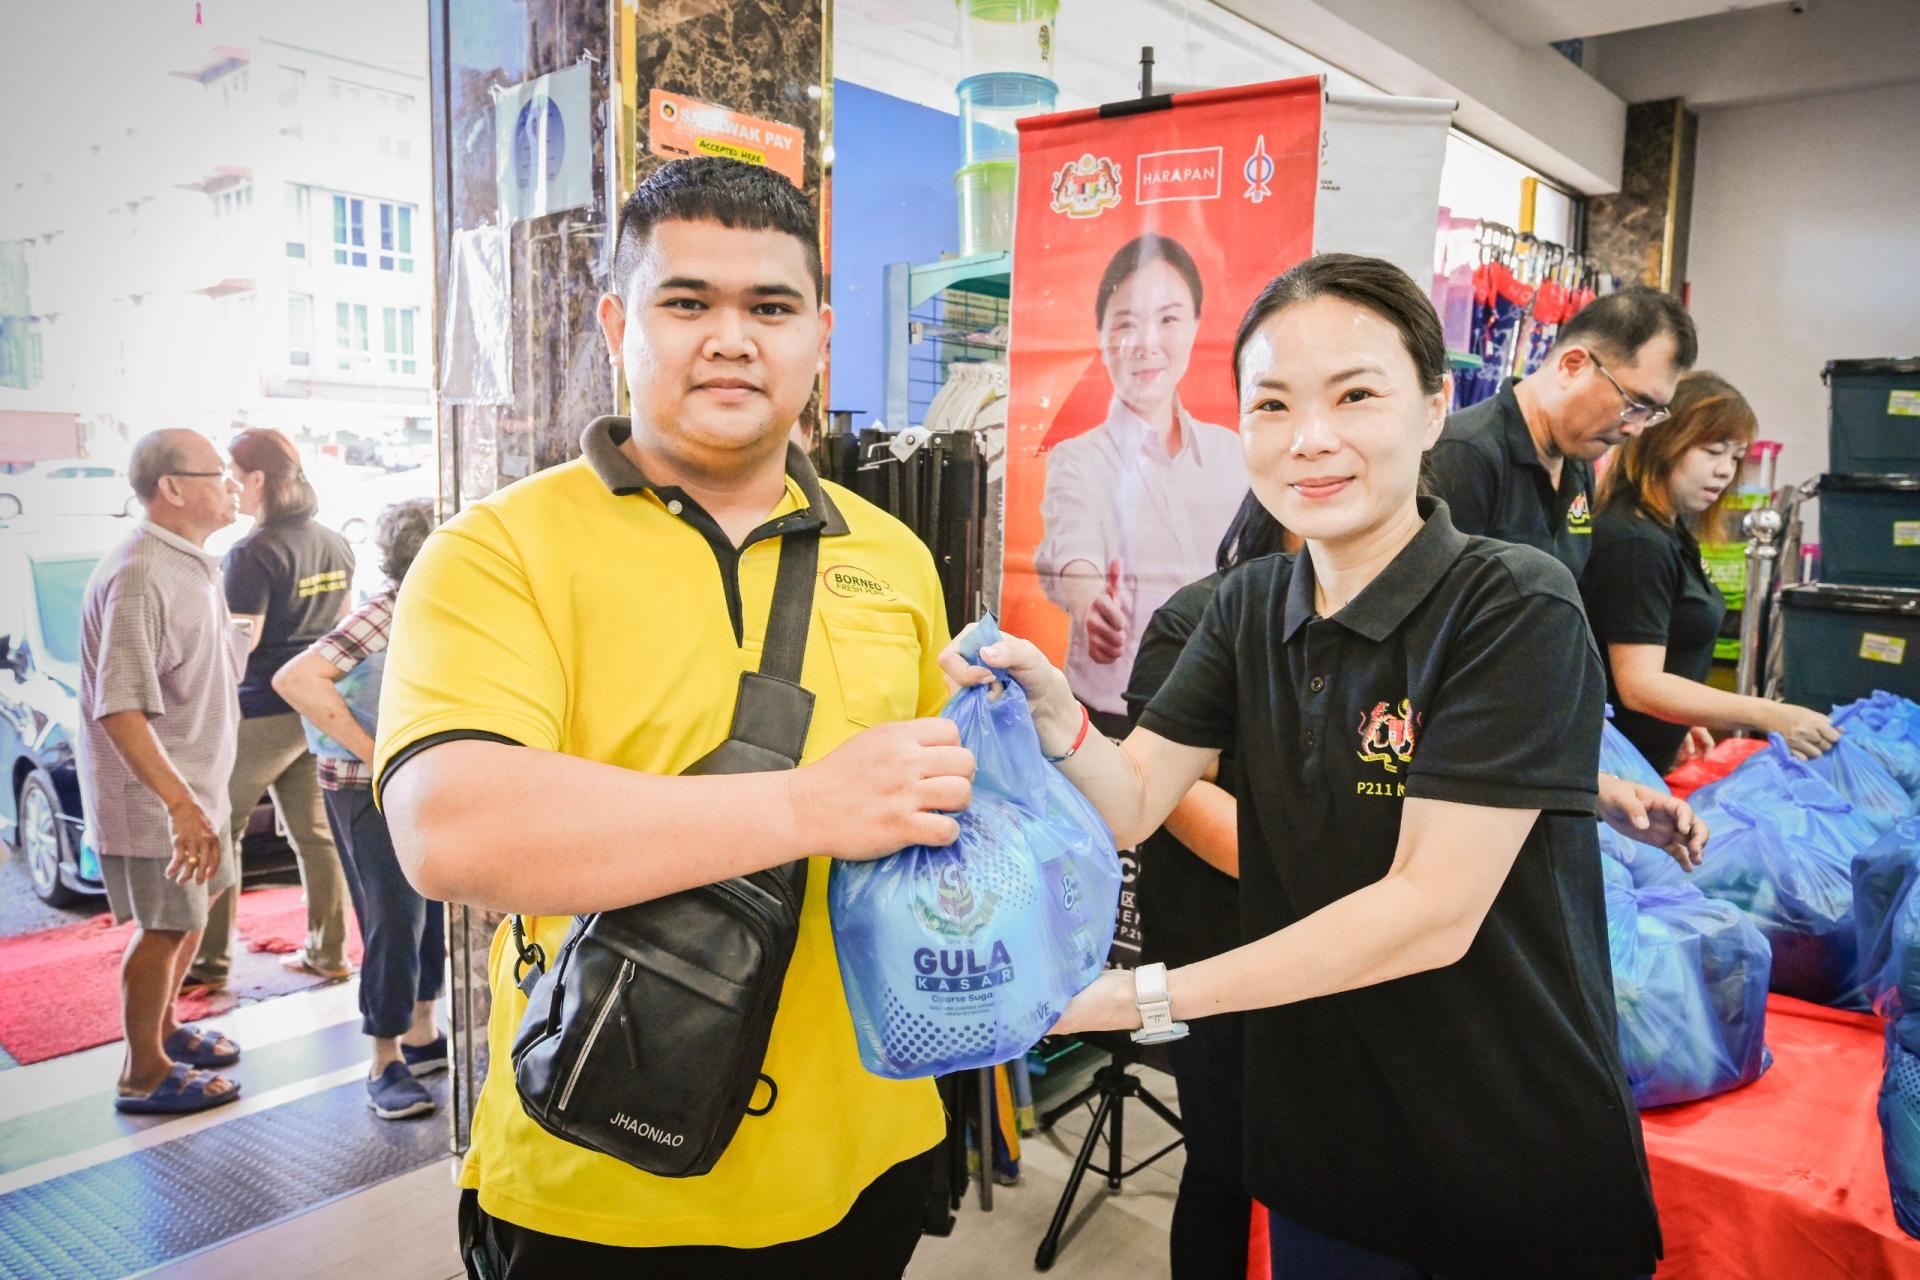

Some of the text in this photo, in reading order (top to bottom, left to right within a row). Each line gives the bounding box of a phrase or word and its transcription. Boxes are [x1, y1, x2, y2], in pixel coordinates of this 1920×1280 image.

[680, 108, 761, 142] SAAWAK
[765, 131, 793, 150] PAY
[699, 140, 738, 156] ACCEPTED
[1143, 167, 1215, 185] HARAPAN
[835, 573, 882, 591] BORNEO
[836, 583, 863, 593] FRESH
[1357, 781, 1392, 796] P211
[913, 939, 1011, 977] GULA
[917, 968, 1013, 991] KASAR
[610, 1112, 684, 1146] JHAONIAO
